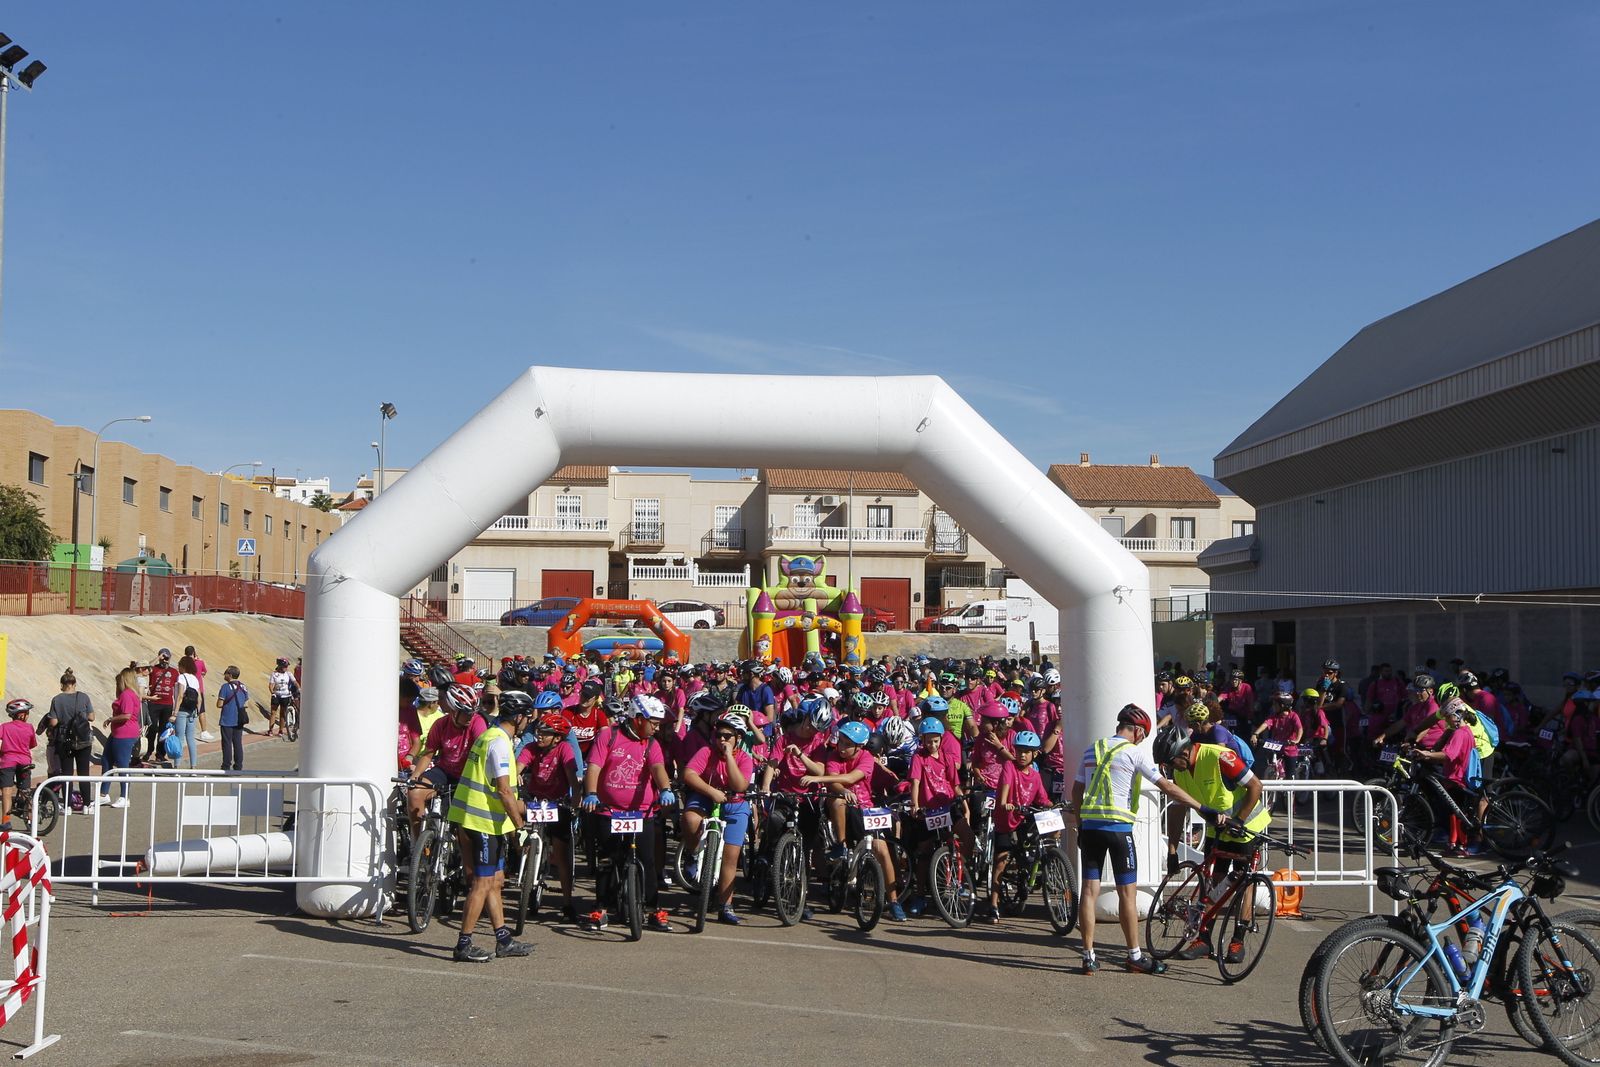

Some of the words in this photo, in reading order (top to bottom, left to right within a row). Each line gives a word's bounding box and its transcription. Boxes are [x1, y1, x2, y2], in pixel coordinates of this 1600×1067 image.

[614, 821, 638, 832] 241
[866, 816, 888, 828] 392
[928, 815, 948, 829] 397
[1482, 922, 1501, 965] BMC
